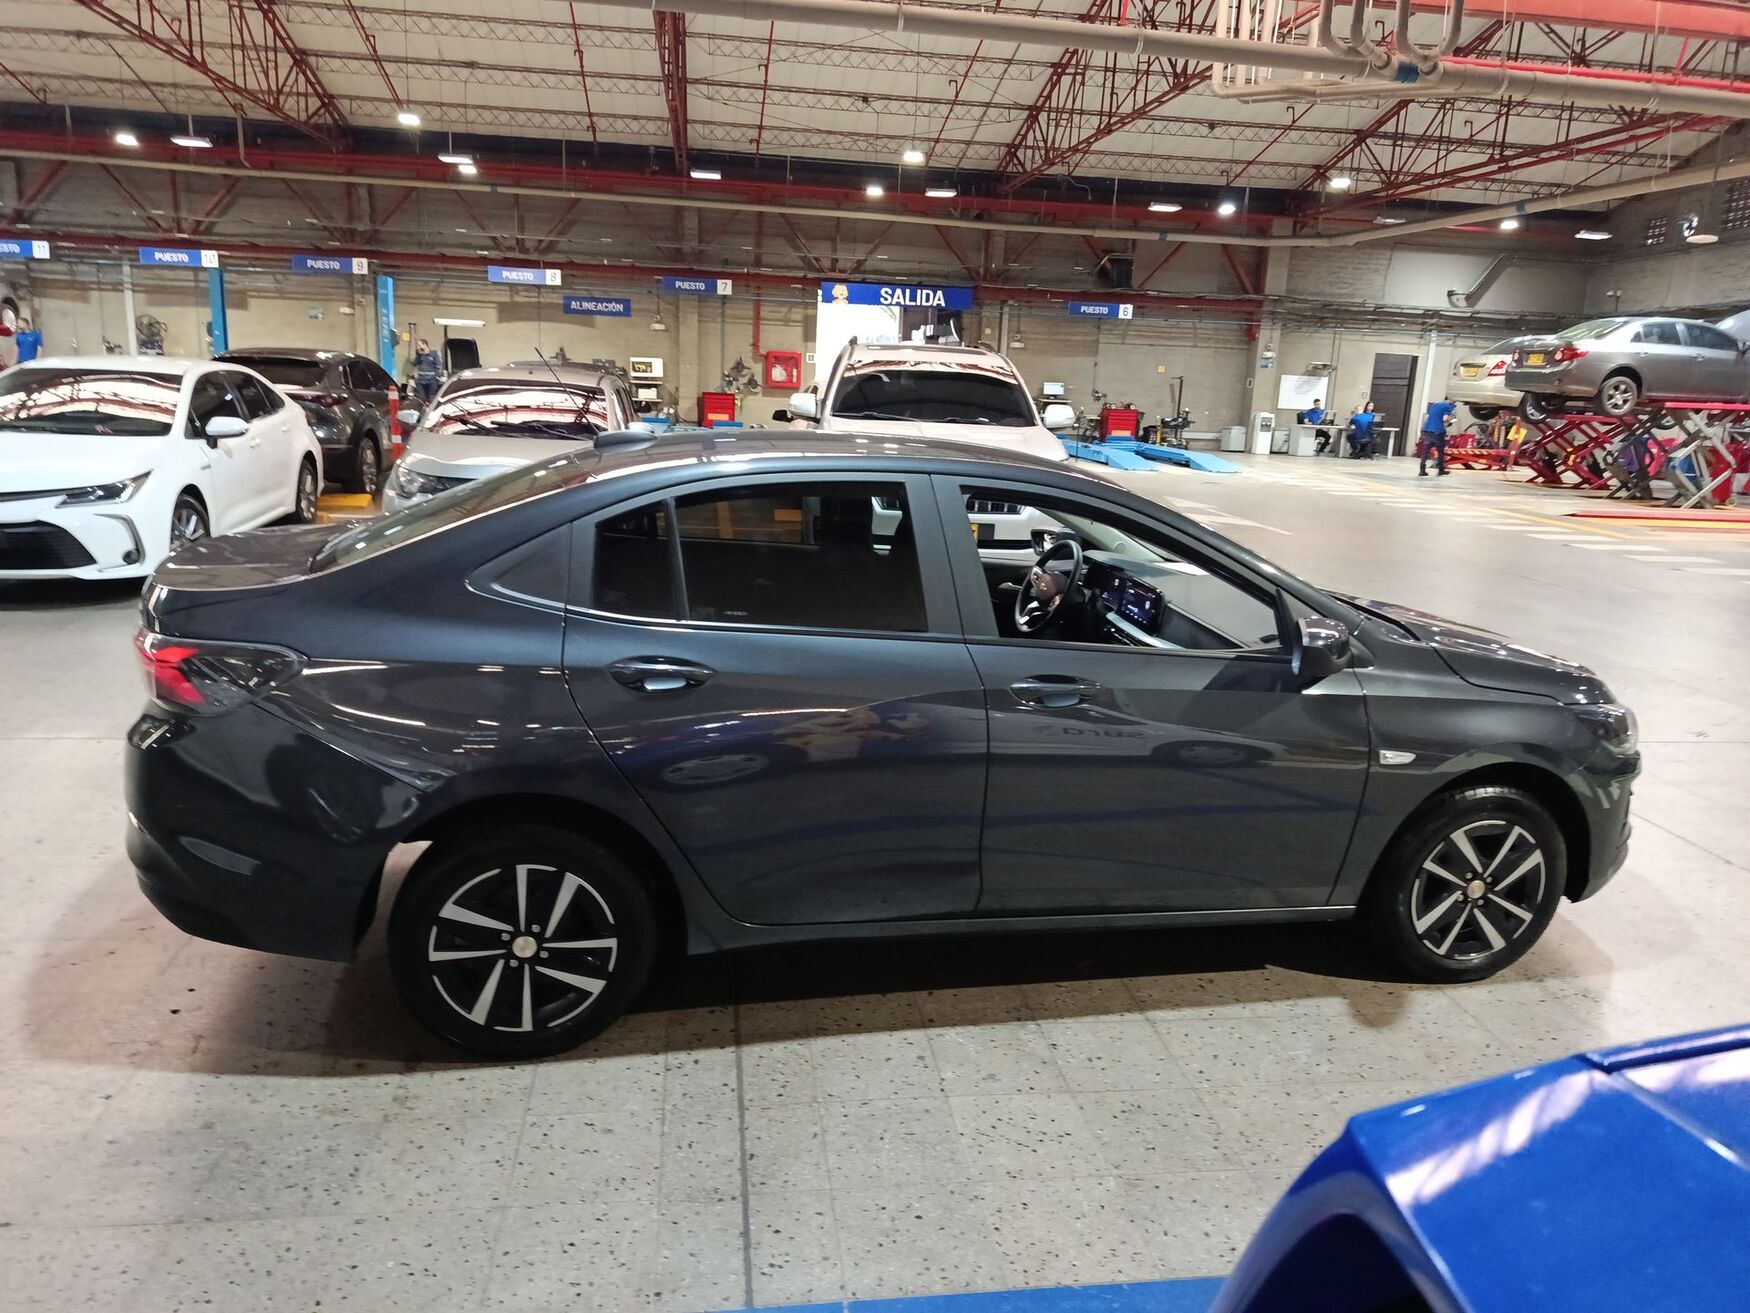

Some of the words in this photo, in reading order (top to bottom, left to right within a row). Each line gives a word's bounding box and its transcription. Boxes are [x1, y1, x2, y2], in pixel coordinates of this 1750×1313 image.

[154, 251, 189, 263] PUESTO
[204, 253, 216, 265] 10
[307, 259, 340, 270] PUESTO
[357, 260, 364, 271] 9
[502, 270, 534, 281] PUESTO
[550, 271, 557, 282] 8
[675, 280, 706, 291] PUESTO
[721, 282, 728, 293] 7
[879, 287, 946, 307] SALIDA
[570, 300, 624, 313] ALINEACIÓN
[1080, 305, 1109, 315] PUESTO
[1122, 306, 1129, 317] 6
